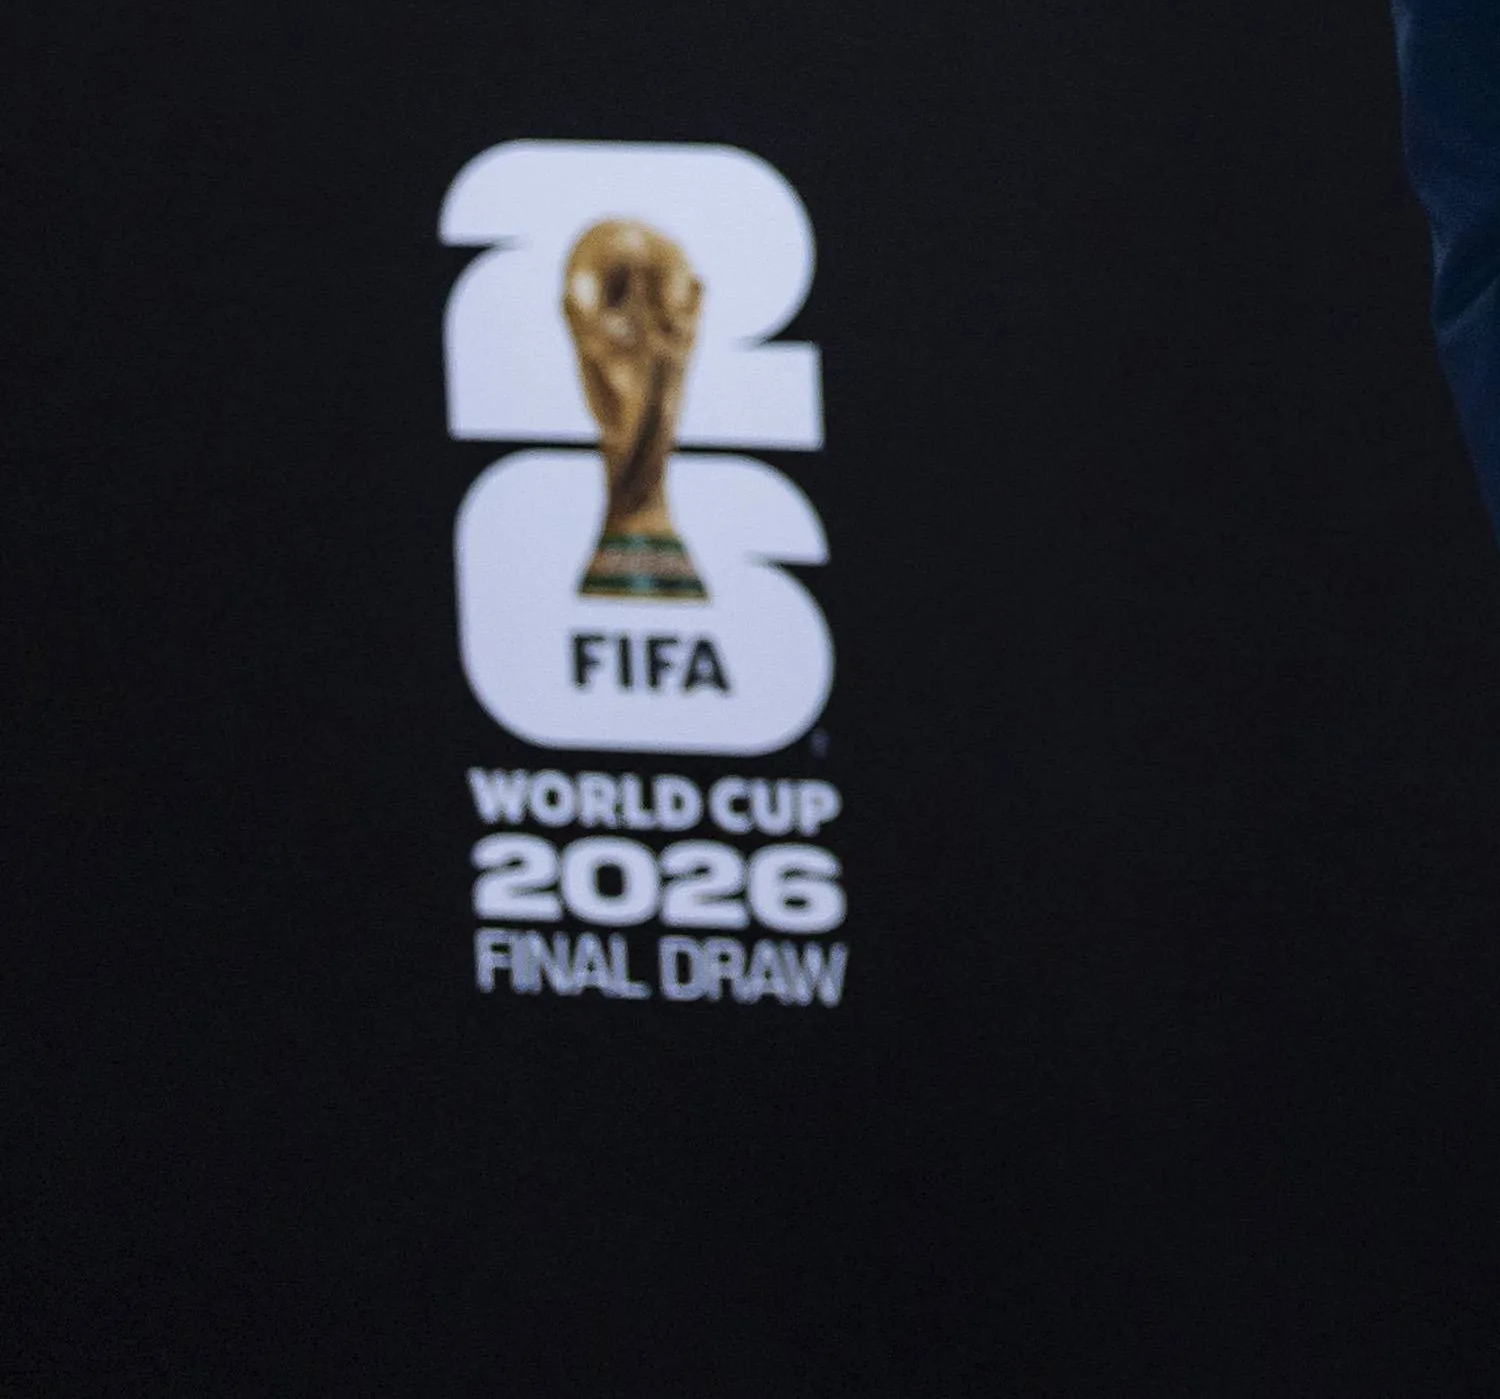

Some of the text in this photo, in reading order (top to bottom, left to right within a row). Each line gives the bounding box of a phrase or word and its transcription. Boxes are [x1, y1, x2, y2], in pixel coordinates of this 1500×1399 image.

[570, 632, 732, 694] FIFA
[468, 768, 841, 836] WORLD CUP
[471, 833, 846, 934] 2026
[474, 927, 848, 1007] FINAL DRAW
